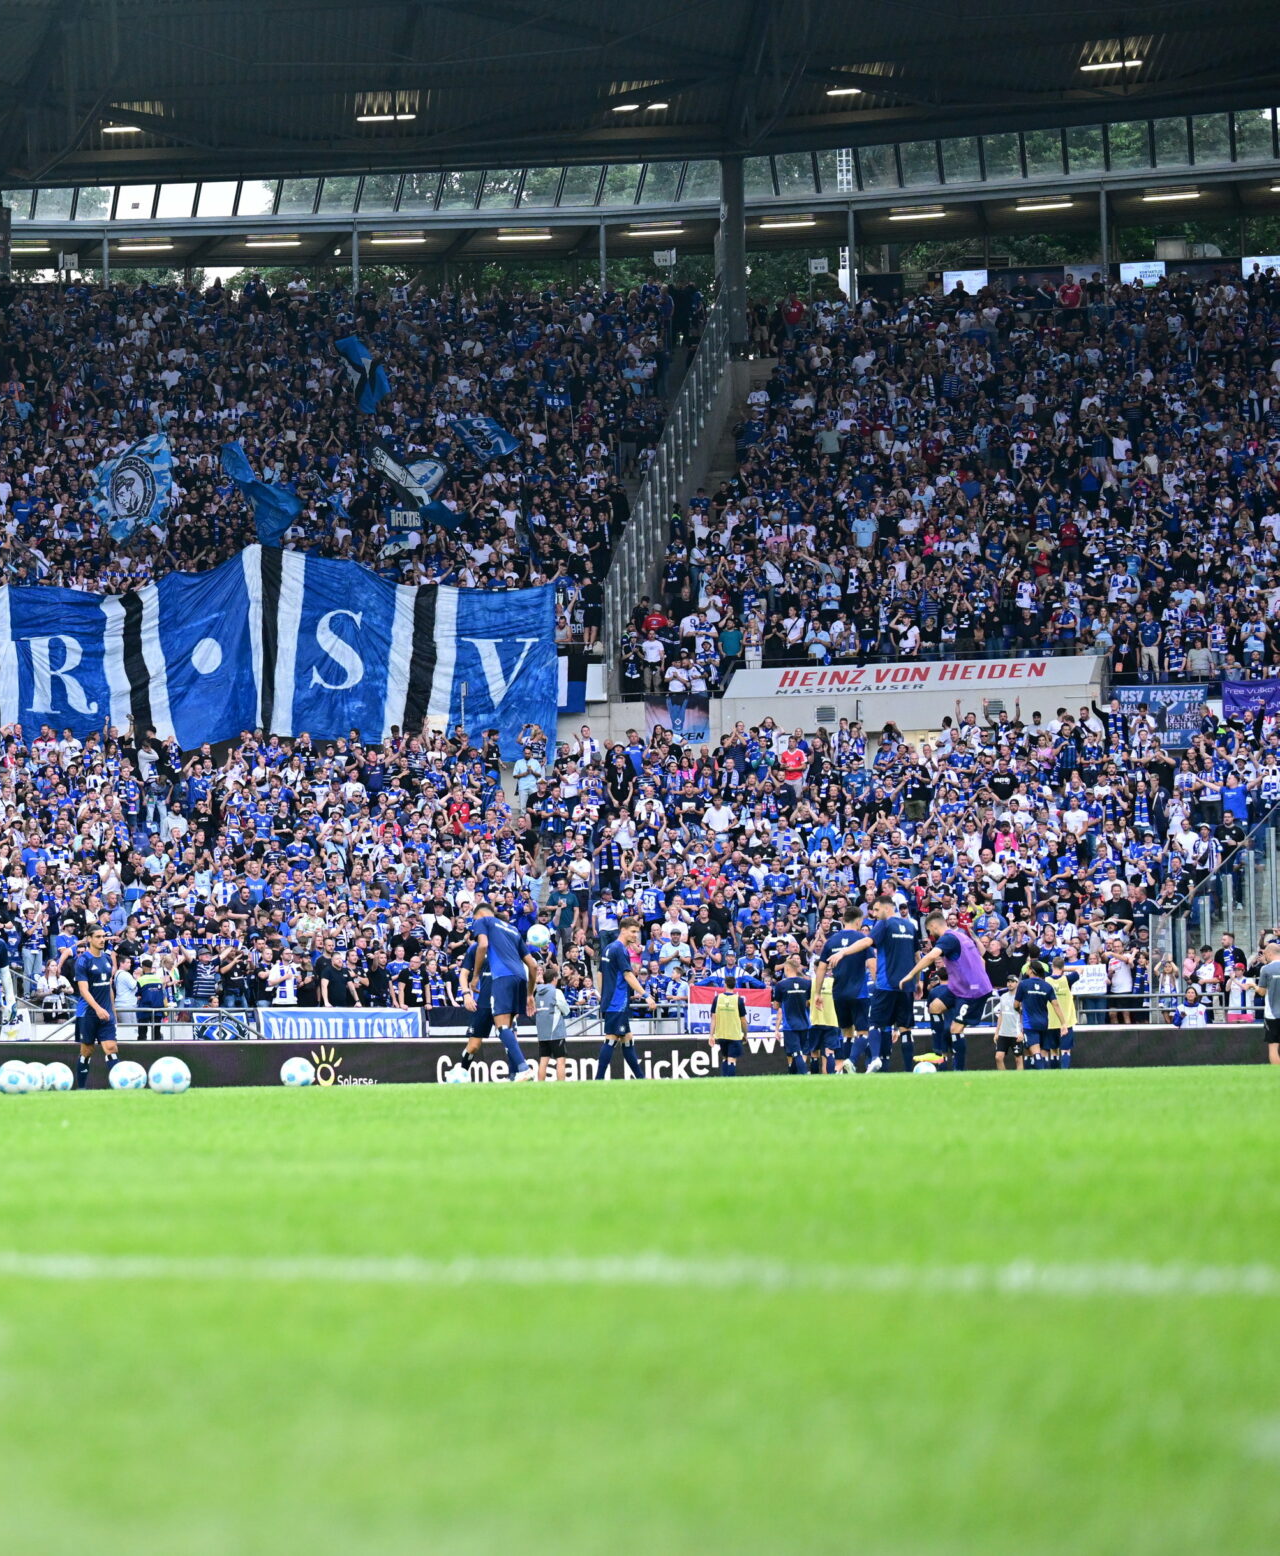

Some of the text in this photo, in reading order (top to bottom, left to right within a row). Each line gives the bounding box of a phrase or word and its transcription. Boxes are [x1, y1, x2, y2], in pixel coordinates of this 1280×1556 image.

[778, 661, 1047, 688] HEINZ VON HEIDEN
[775, 683, 925, 696] MASSIVHÄUSER
[1120, 690, 1144, 702] HSV
[1224, 687, 1245, 695] Free
[643, 895, 656, 910] 38
[268, 1017, 414, 1039] NORDHAUSEN
